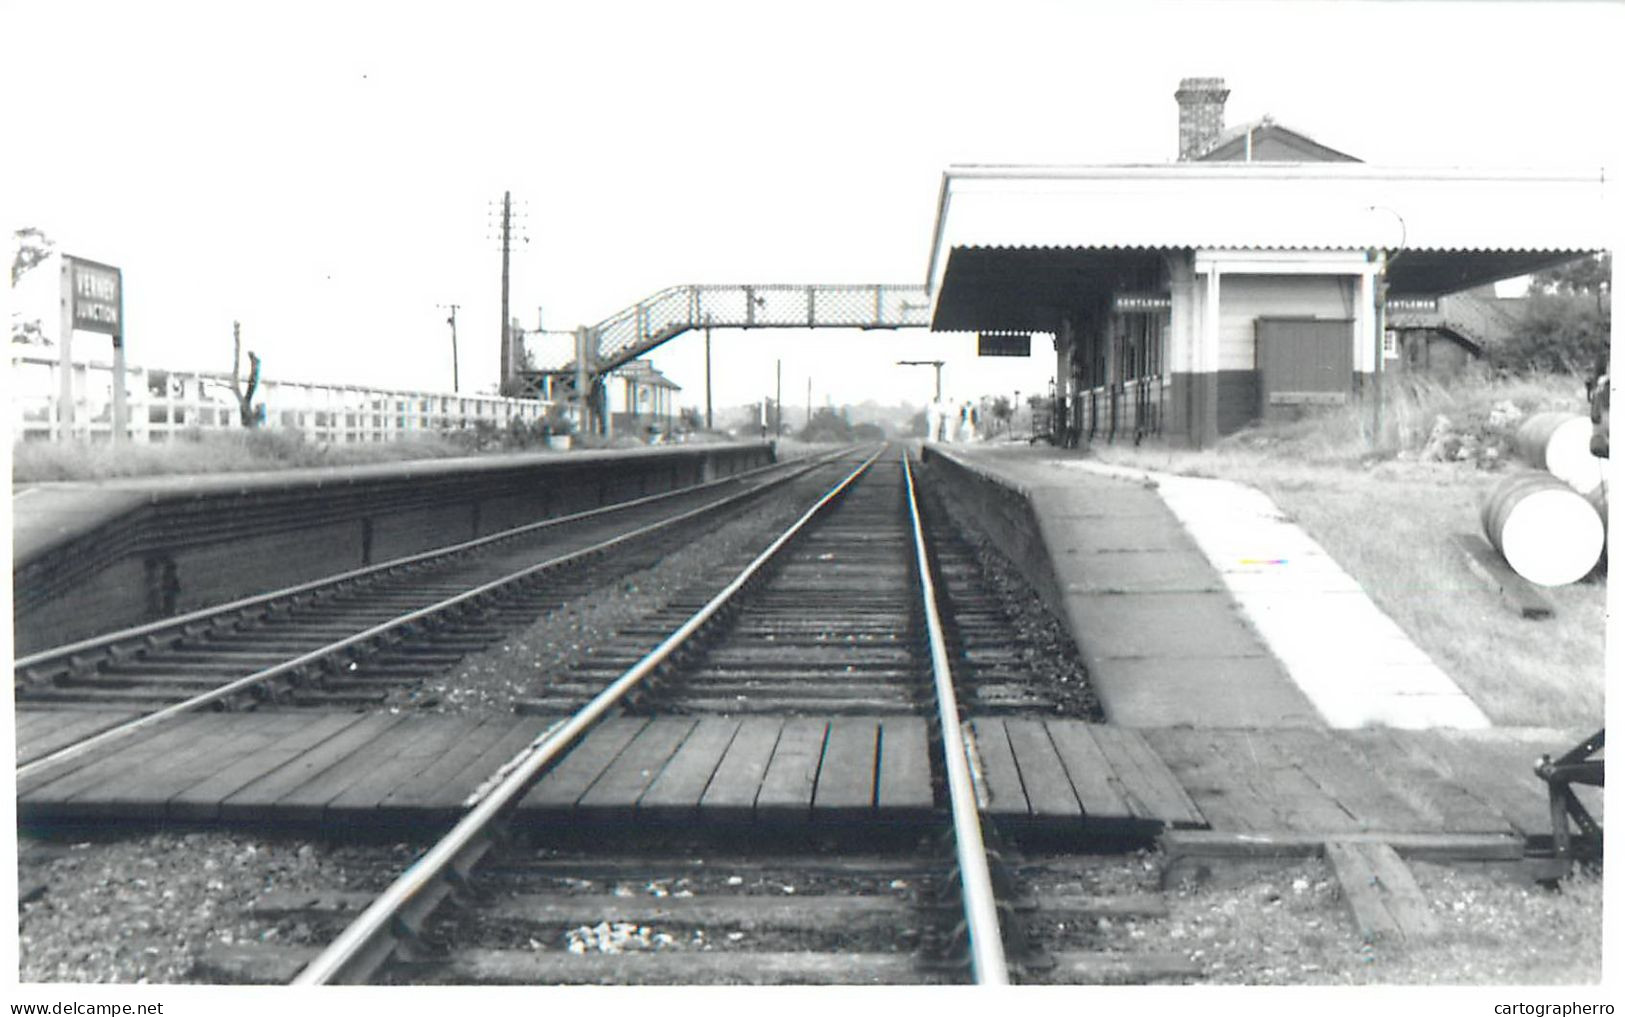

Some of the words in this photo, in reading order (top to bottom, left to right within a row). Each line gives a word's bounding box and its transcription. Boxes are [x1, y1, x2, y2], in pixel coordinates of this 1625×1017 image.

[77, 272, 115, 301] VERNEY
[76, 302, 117, 323] JUNCTION
[1388, 299, 1435, 308] ENTLEMEN
